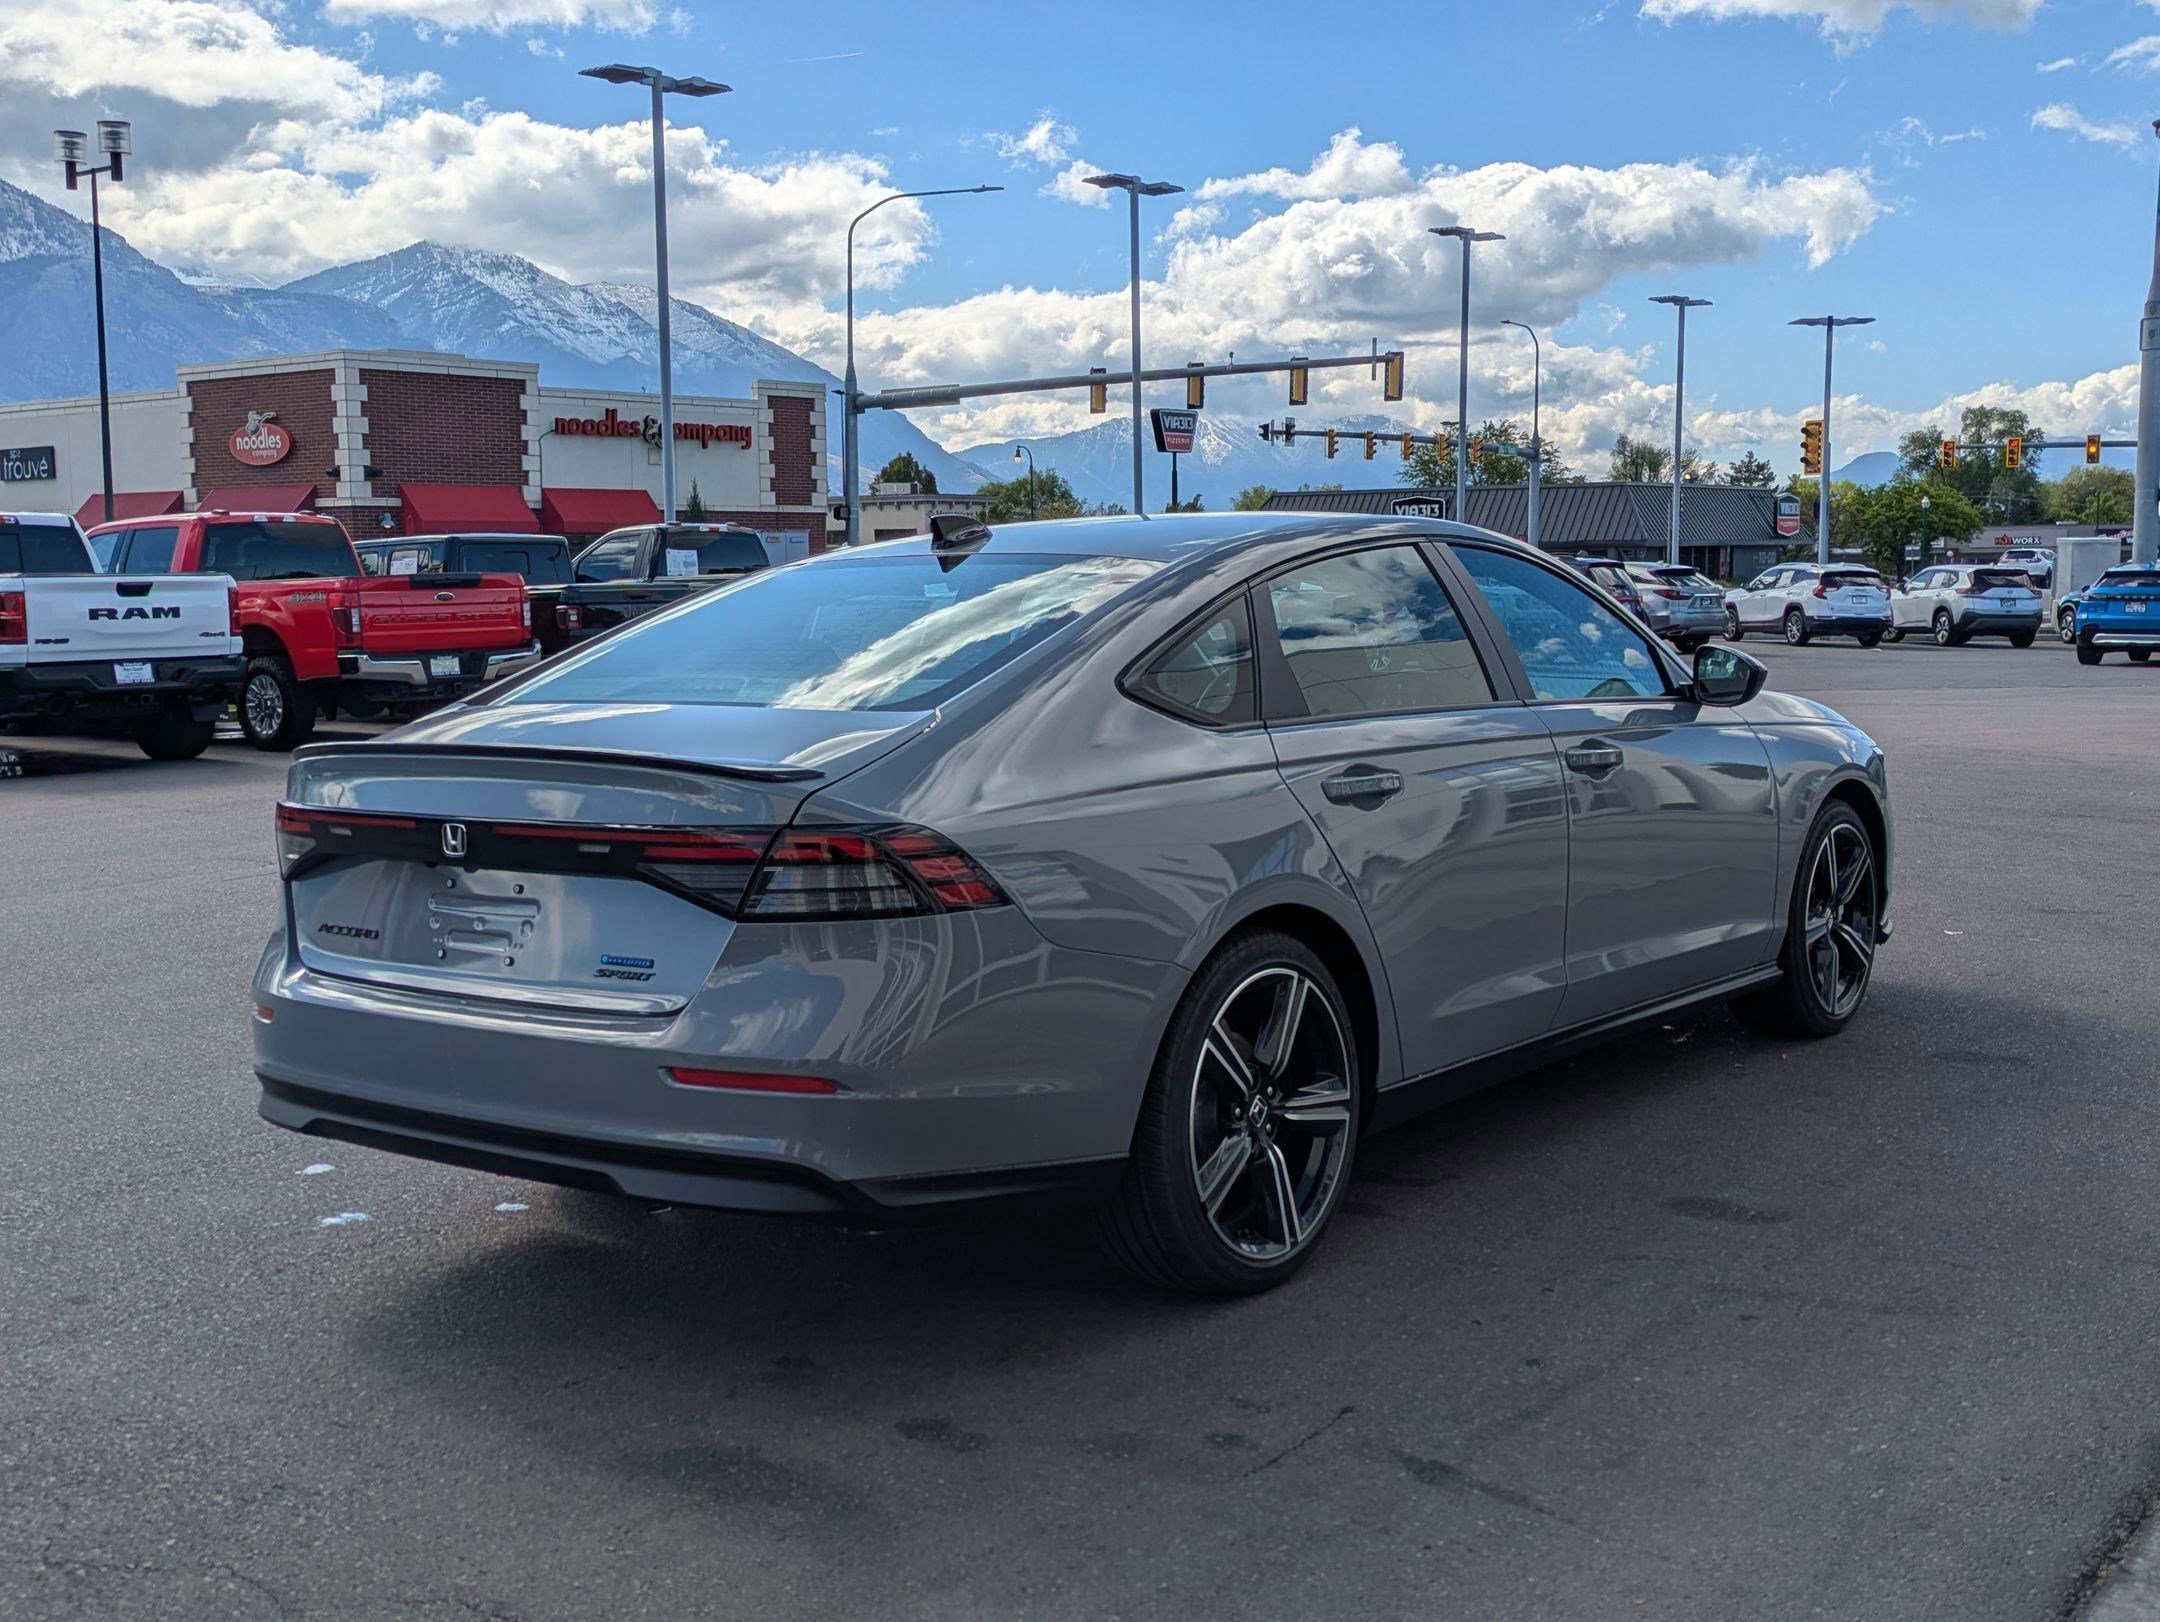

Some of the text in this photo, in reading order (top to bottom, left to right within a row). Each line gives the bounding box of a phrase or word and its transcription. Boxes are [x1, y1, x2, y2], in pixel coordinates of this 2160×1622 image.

[555, 408, 641, 438] noodles
[659, 421, 752, 449] ompany
[236, 427, 282, 450] noodles
[3, 456, 48, 480] trouvé
[1995, 533, 2041, 545] HOTWORX
[88, 606, 181, 620] RAM
[318, 923, 380, 940] ACCORD
[593, 968, 657, 982] SPORT
